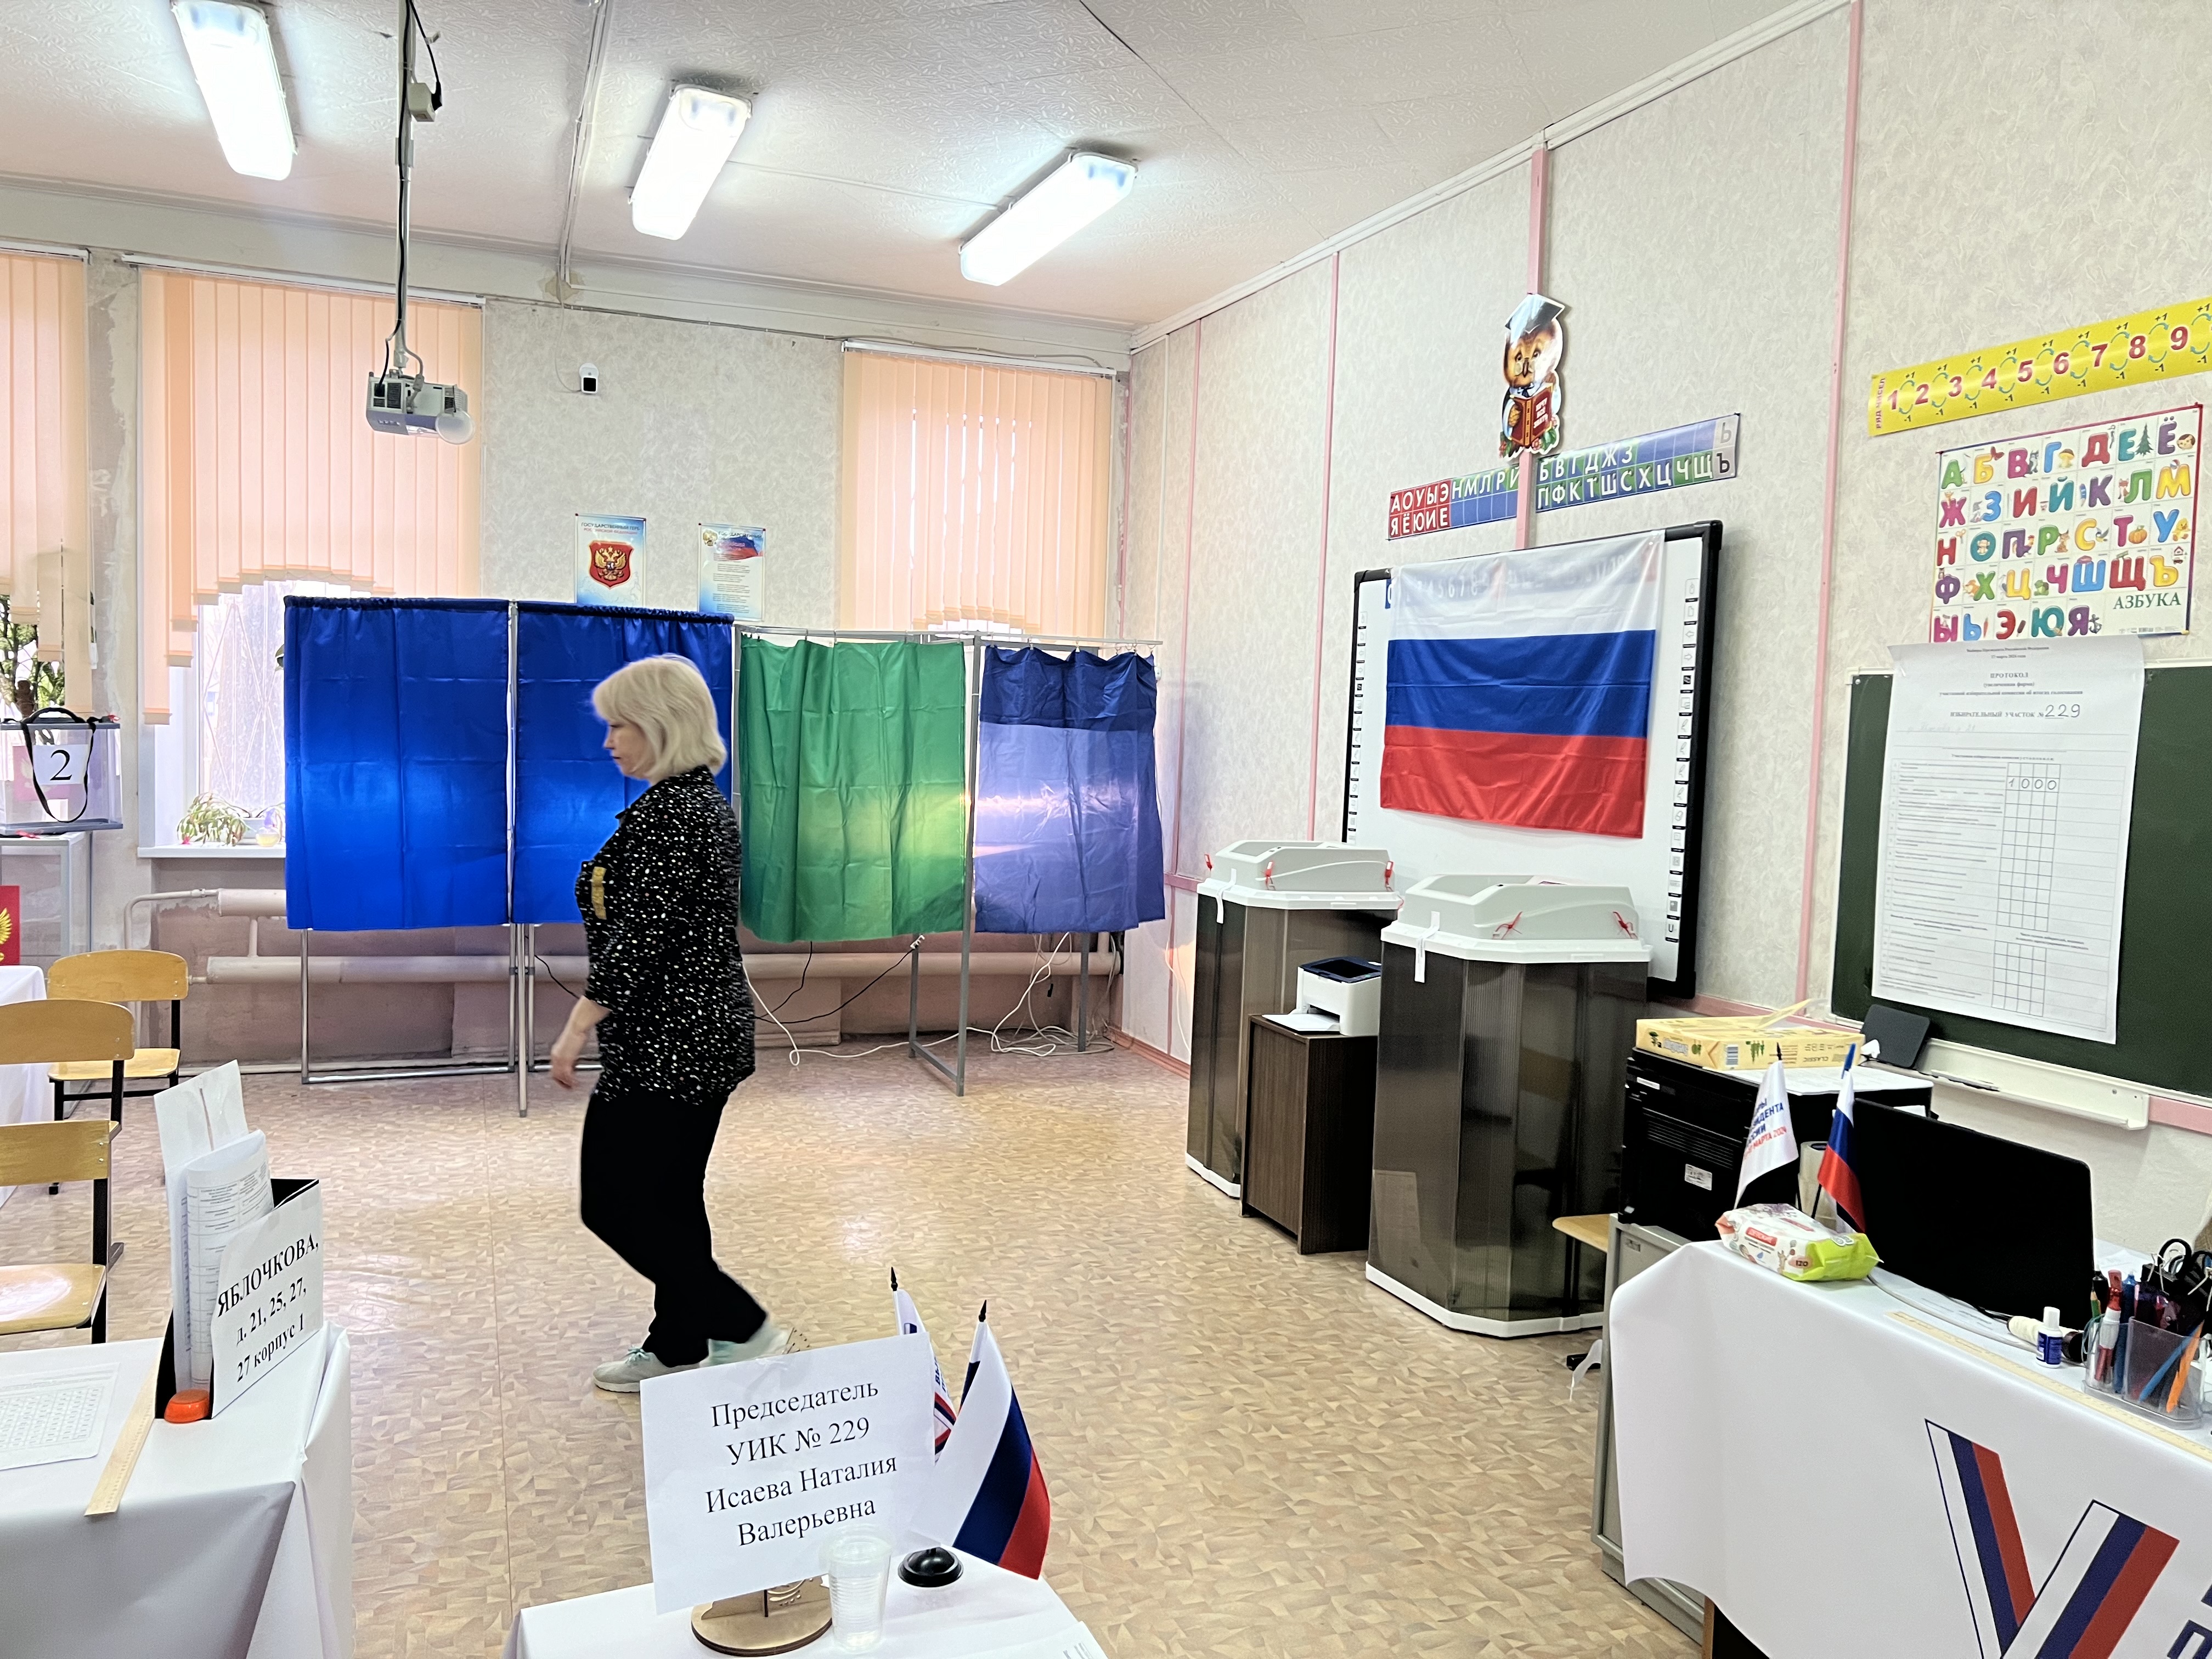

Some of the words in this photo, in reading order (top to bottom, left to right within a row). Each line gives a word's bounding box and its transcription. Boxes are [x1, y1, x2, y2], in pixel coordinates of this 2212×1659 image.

[2155, 313, 2168, 321] +1
[2197, 303, 2210, 312] +1
[1887, 390, 1898, 410] 1
[1915, 384, 1929, 405] 2
[1949, 376, 1962, 397] 3
[1982, 368, 1997, 389] 4
[2018, 360, 2033, 382] 5
[2053, 352, 2069, 374] 6
[2091, 343, 2108, 367] 7
[2129, 336, 2146, 359] 8
[2171, 326, 2188, 350] 9
[2197, 355, 2207, 363] -1
[1716, 453, 1730, 473] Ъ
[1941, 459, 1962, 489] А
[1973, 453, 1994, 484] Б
[2007, 448, 2028, 478] В
[2044, 442, 2062, 473] Г
[2081, 432, 2110, 467] Д
[2118, 428, 2136, 461] Е
[2158, 416, 2177, 455] Ё
[1939, 496, 1967, 528] Ж
[1982, 490, 2001, 522] З
[2013, 486, 2037, 518] И
[2049, 476, 2074, 512] Й
[2089, 475, 2113, 507] К
[2124, 469, 2152, 504] Л
[2156, 464, 2191, 499] М
[1937, 537, 1956, 566] Н
[1970, 531, 1996, 562] О
[2002, 528, 2026, 559] П
[2038, 525, 2060, 555] Р
[2075, 518, 2097, 551] С
[2114, 515, 2134, 547] Т
[2153, 509, 2180, 543] У
[1935, 574, 1960, 604] Ф
[1973, 571, 1996, 601] Х
[2006, 568, 2031, 600] Ц
[2047, 563, 2068, 594] Ч
[2072, 560, 2106, 592] Ш
[2109, 556, 2146, 591] Щ
[2149, 555, 2179, 587] Ъ
[2113, 592, 2181, 610] АЗБУКА
[1933, 614, 1959, 642] Ы
[1963, 613, 1982, 641] Ь
[1996, 609, 2016, 639] Э
[2031, 606, 2064, 637] Ю
[2068, 605, 2090, 636] Я
[2045, 704, 2080, 718] 229
[50, 749, 72, 781] 2
[218, 1233, 319, 1318] ЯБЛОЧКОВА,
[236, 1327, 247, 1347] д.
[250, 1307, 267, 1333] 21,
[270, 1291, 286, 1317] 25,
[290, 1277, 307, 1302] 27,
[237, 1355, 250, 1383] 27
[254, 1324, 295, 1367] корпус
[299, 1313, 303, 1331] 1
[711, 1383, 878, 1430] Председатель
[726, 1434, 787, 1465] УИК
[795, 1428, 821, 1452] №
[828, 1417, 869, 1444] 229
[705, 1480, 793, 1513] Исаева
[799, 1457, 897, 1492] Наталия
[737, 1499, 876, 1546] Валерьевна
